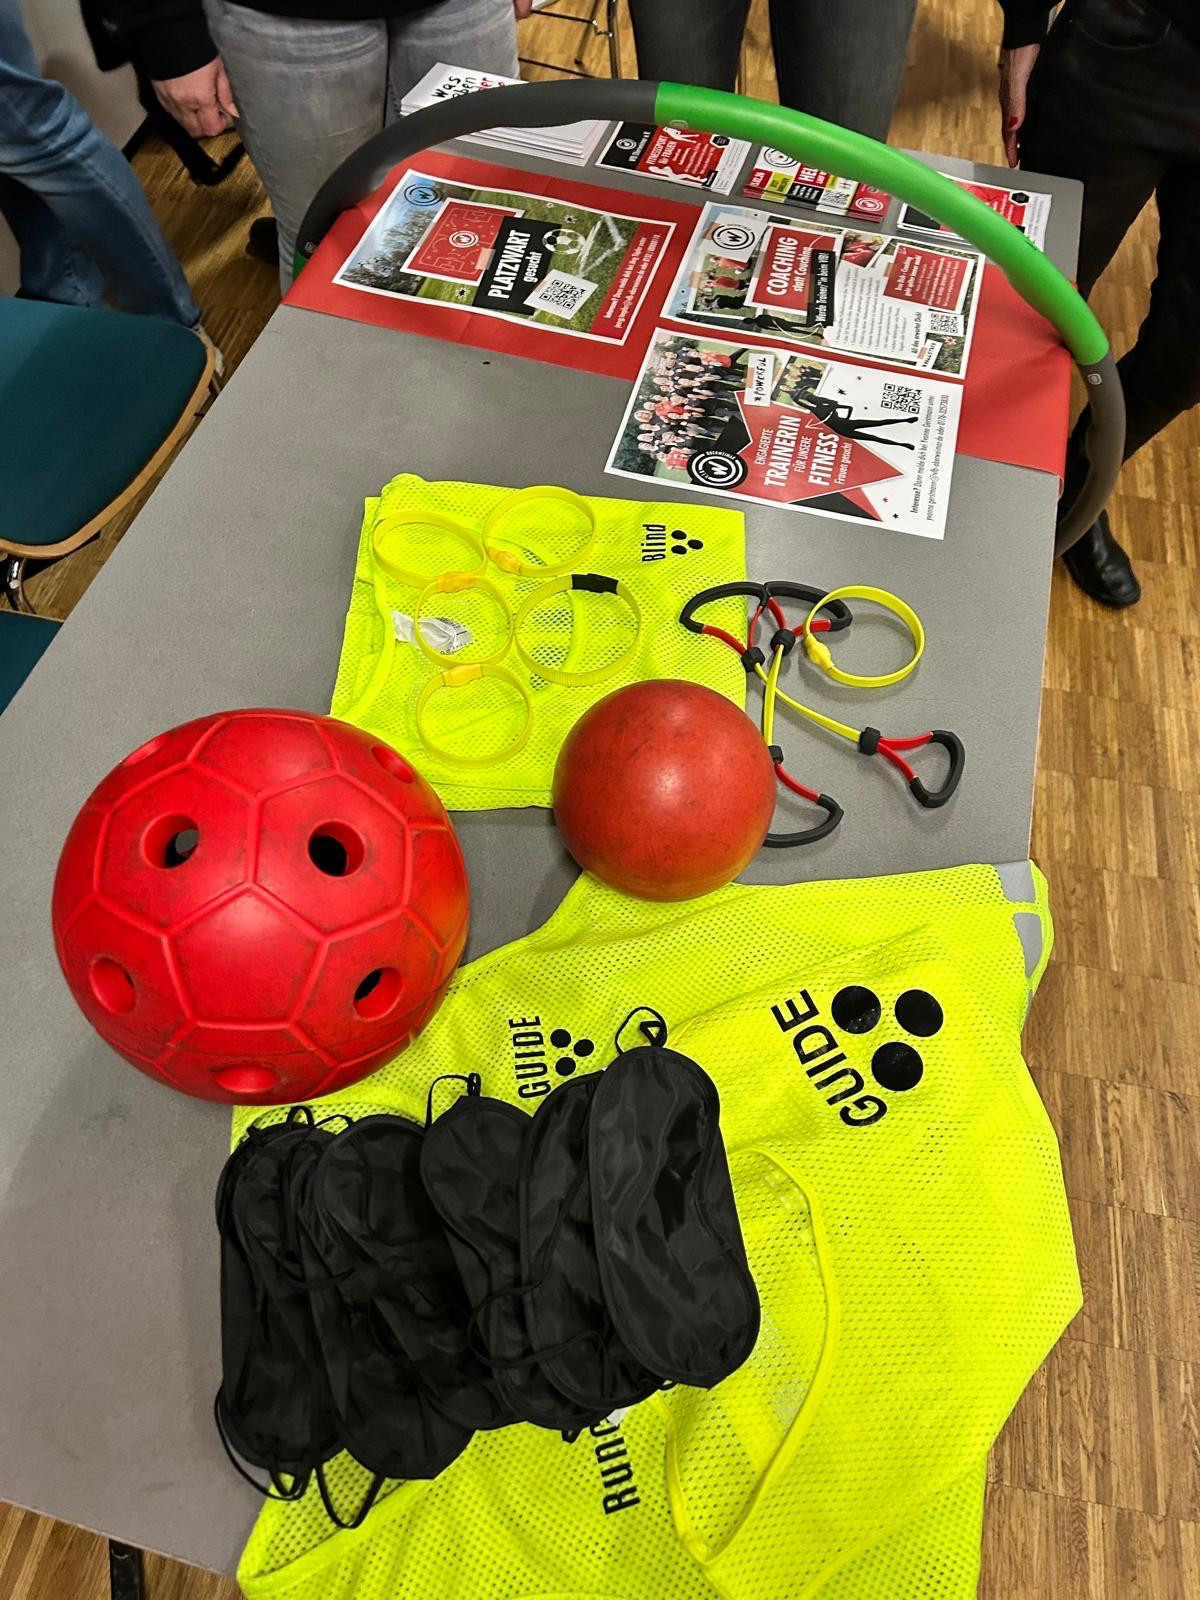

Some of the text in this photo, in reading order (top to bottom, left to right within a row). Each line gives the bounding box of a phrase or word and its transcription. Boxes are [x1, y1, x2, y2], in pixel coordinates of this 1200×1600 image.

[488, 230, 530, 299] PLATZWART
[524, 252, 542, 282] gesucht
[766, 236, 798, 296] COACHING
[816, 264, 829, 275] beim
[792, 276, 804, 292] statt
[815, 305, 827, 322] Werde
[754, 428, 775, 466] ENGAGIERTE
[764, 415, 802, 487] TRAINERIN
[792, 436, 812, 472] FÜR UNSERE
[808, 432, 840, 486] FITNESS
[834, 442, 852, 484] Frauen gesucht
[917, 451, 926, 460] dich
[708, 460, 728, 475] W
[916, 460, 925, 474] melde
[910, 487, 921, 513] Interesse?
[642, 524, 666, 562] Blind
[508, 1015, 552, 1099] GUIDE
[771, 989, 888, 1127] GUIDE
